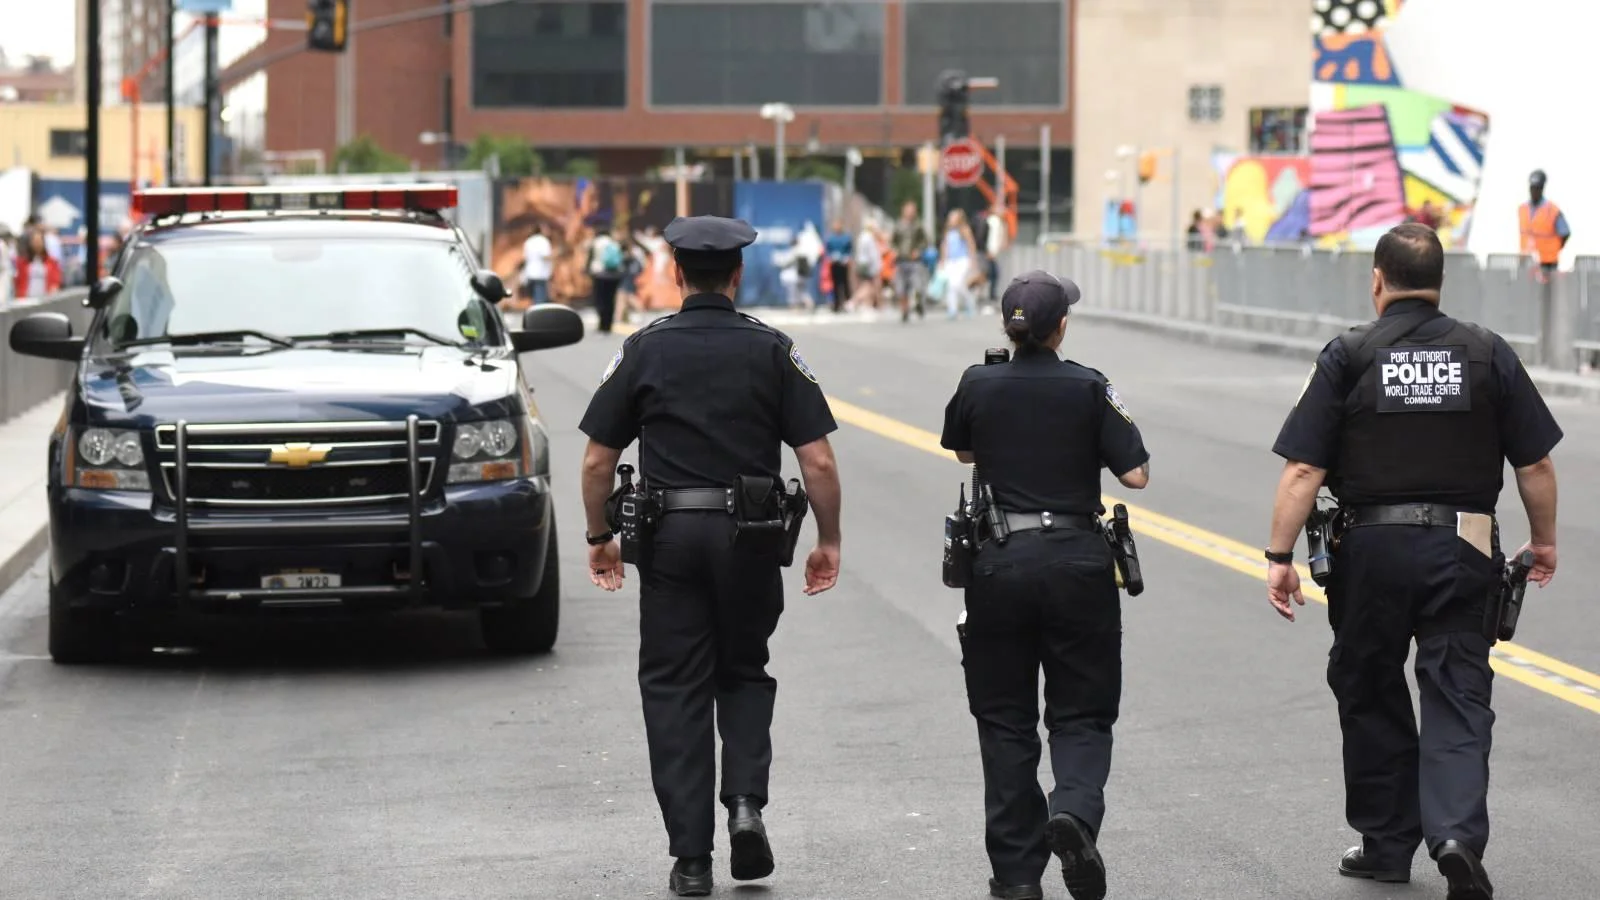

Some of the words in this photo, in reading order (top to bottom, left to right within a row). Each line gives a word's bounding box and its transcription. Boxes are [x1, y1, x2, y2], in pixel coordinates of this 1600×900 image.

[944, 154, 980, 172] STOP
[1390, 352, 1410, 363] PORT
[1412, 350, 1452, 363] AUTHORITY
[1382, 362, 1462, 385] POLICE
[1384, 385, 1409, 397] WORLD
[1411, 384, 1433, 396] TRADE
[1434, 384, 1461, 396] CENTER
[1404, 396, 1442, 405] COMMAND
